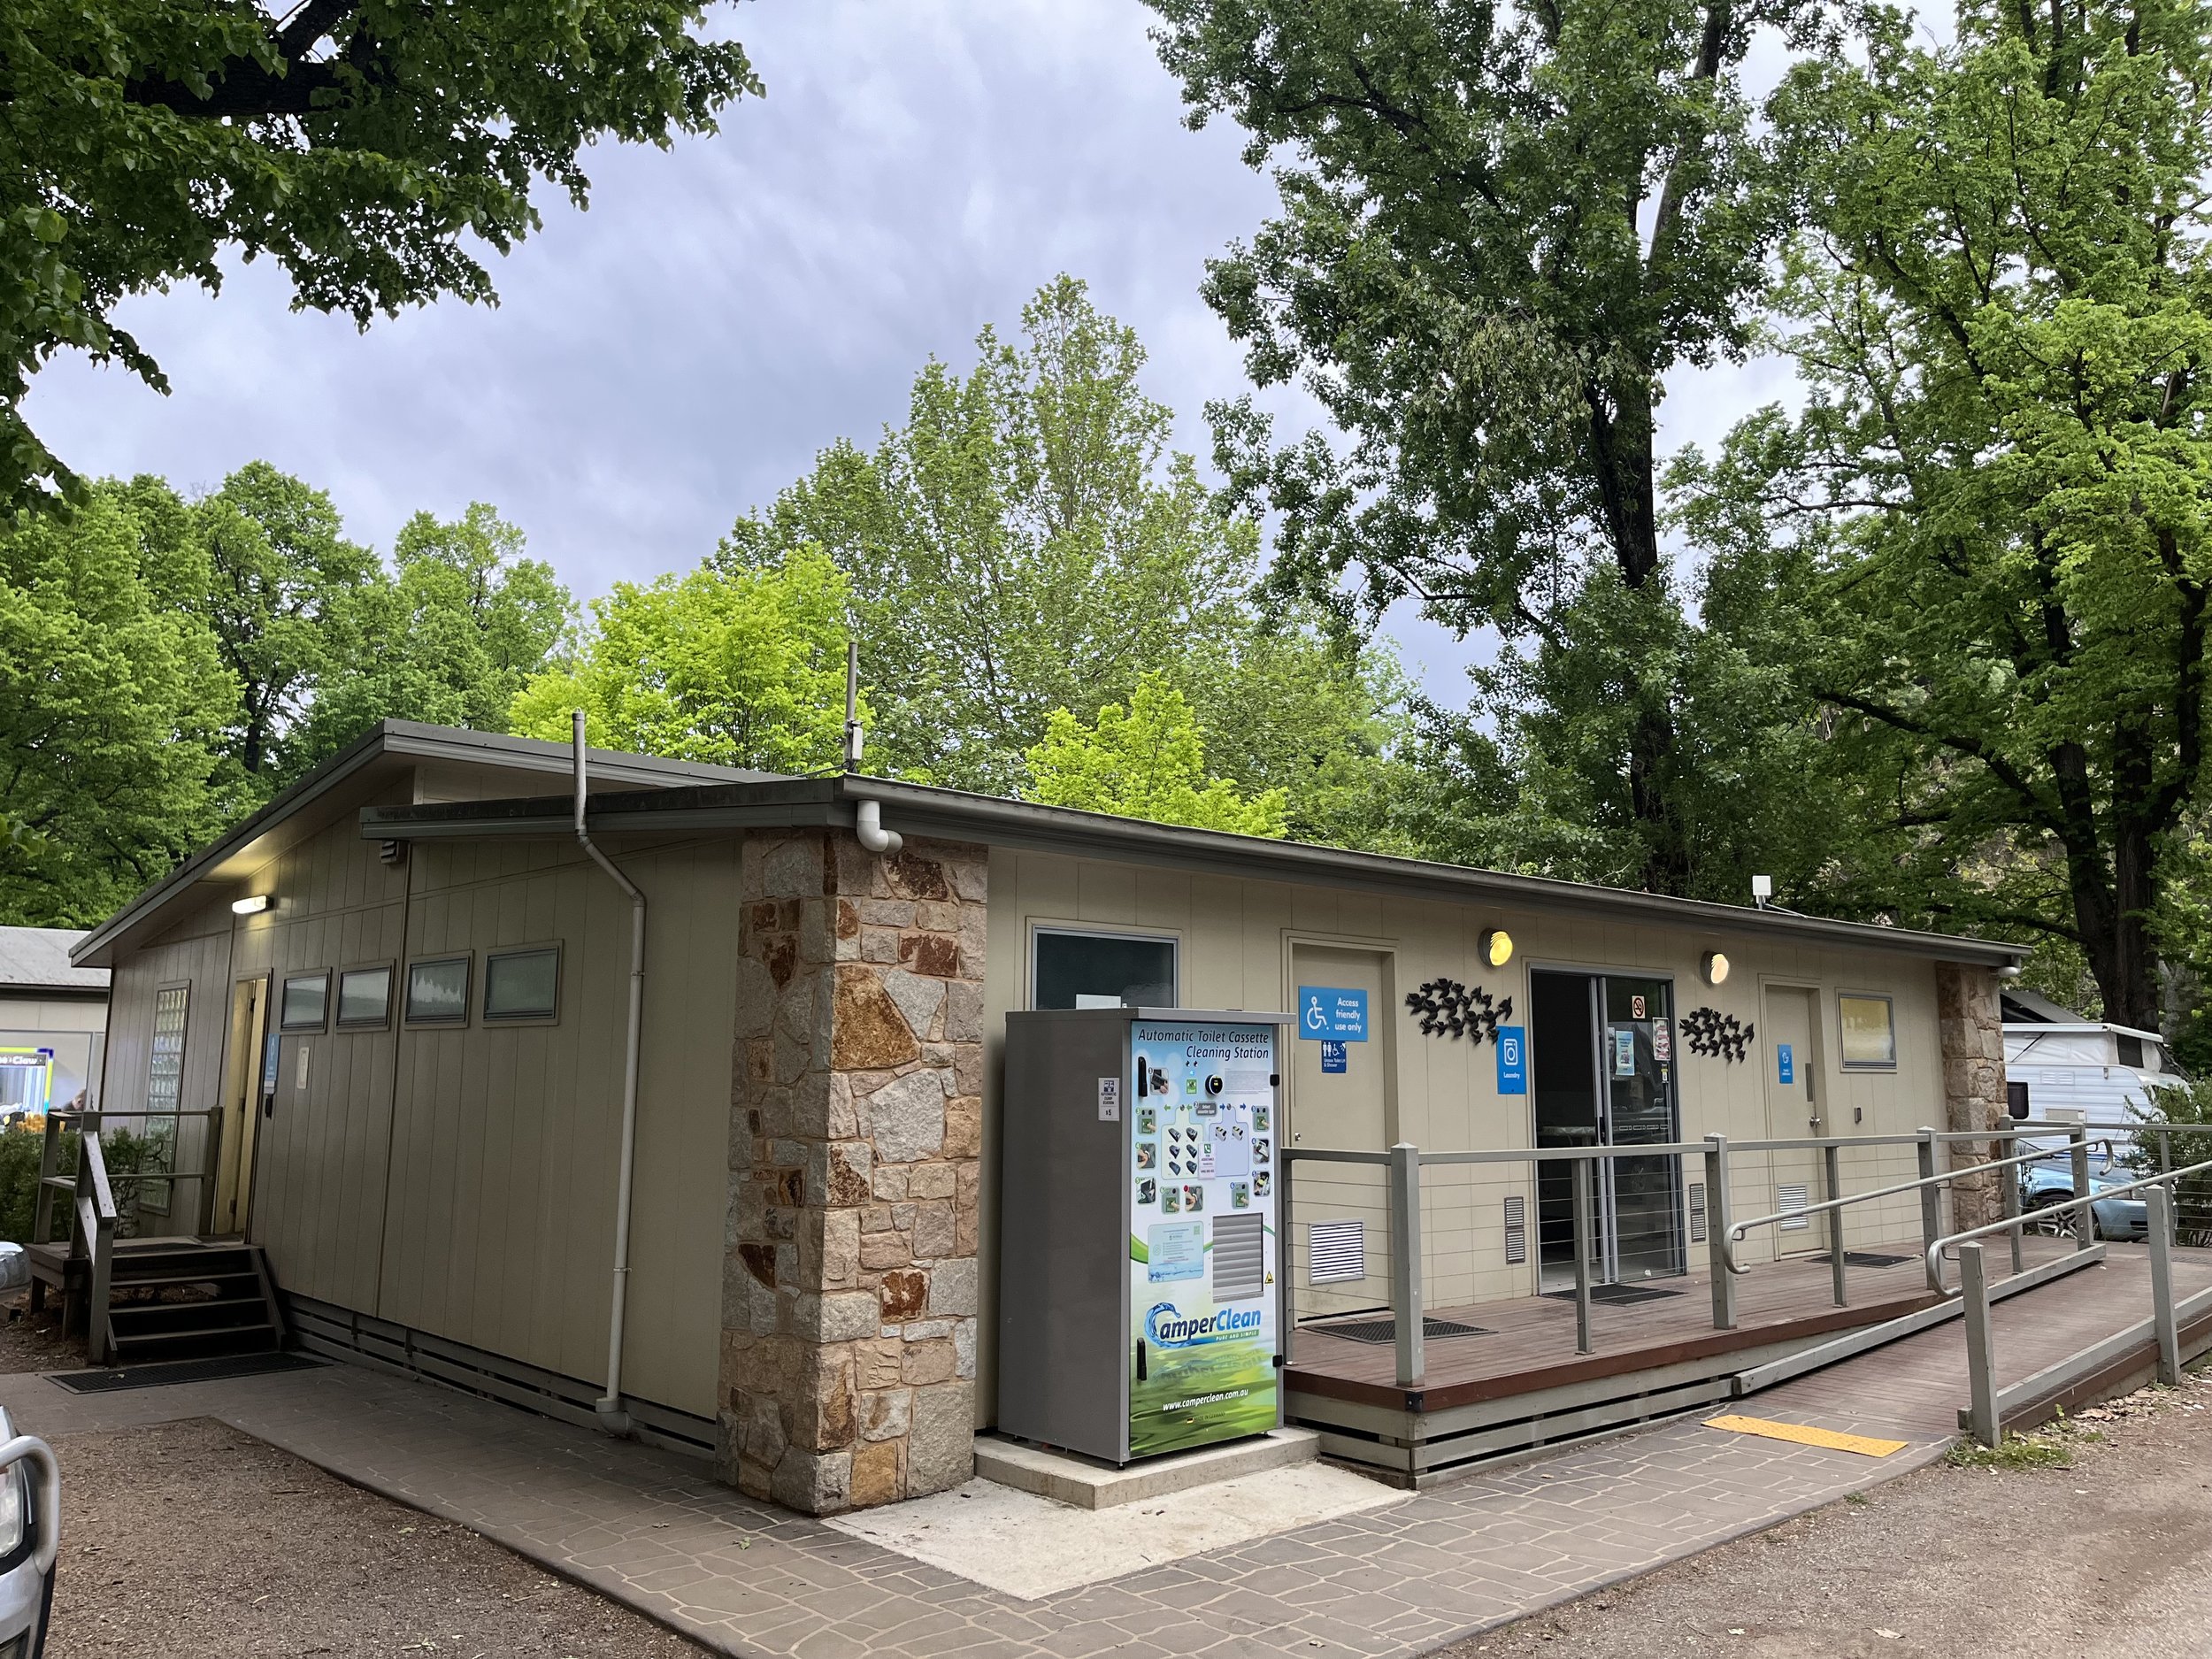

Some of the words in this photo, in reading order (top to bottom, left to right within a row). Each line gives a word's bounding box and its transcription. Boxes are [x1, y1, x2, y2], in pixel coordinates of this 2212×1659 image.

[1337, 997, 1359, 1007] Access
[1335, 1010, 1361, 1021] friendly
[1348, 1023, 1361, 1033] only
[1138, 1029, 1194, 1042] Automatic
[1198, 1030, 1225, 1043] Toilet
[1228, 1031, 1269, 1043] Cassette
[1186, 1045, 1231, 1061] Cleaning
[1234, 1046, 1269, 1059] Station
[1503, 1071, 1520, 1080] Laundry
[1163, 1388, 1248, 1411] www.camperclean.com.au
